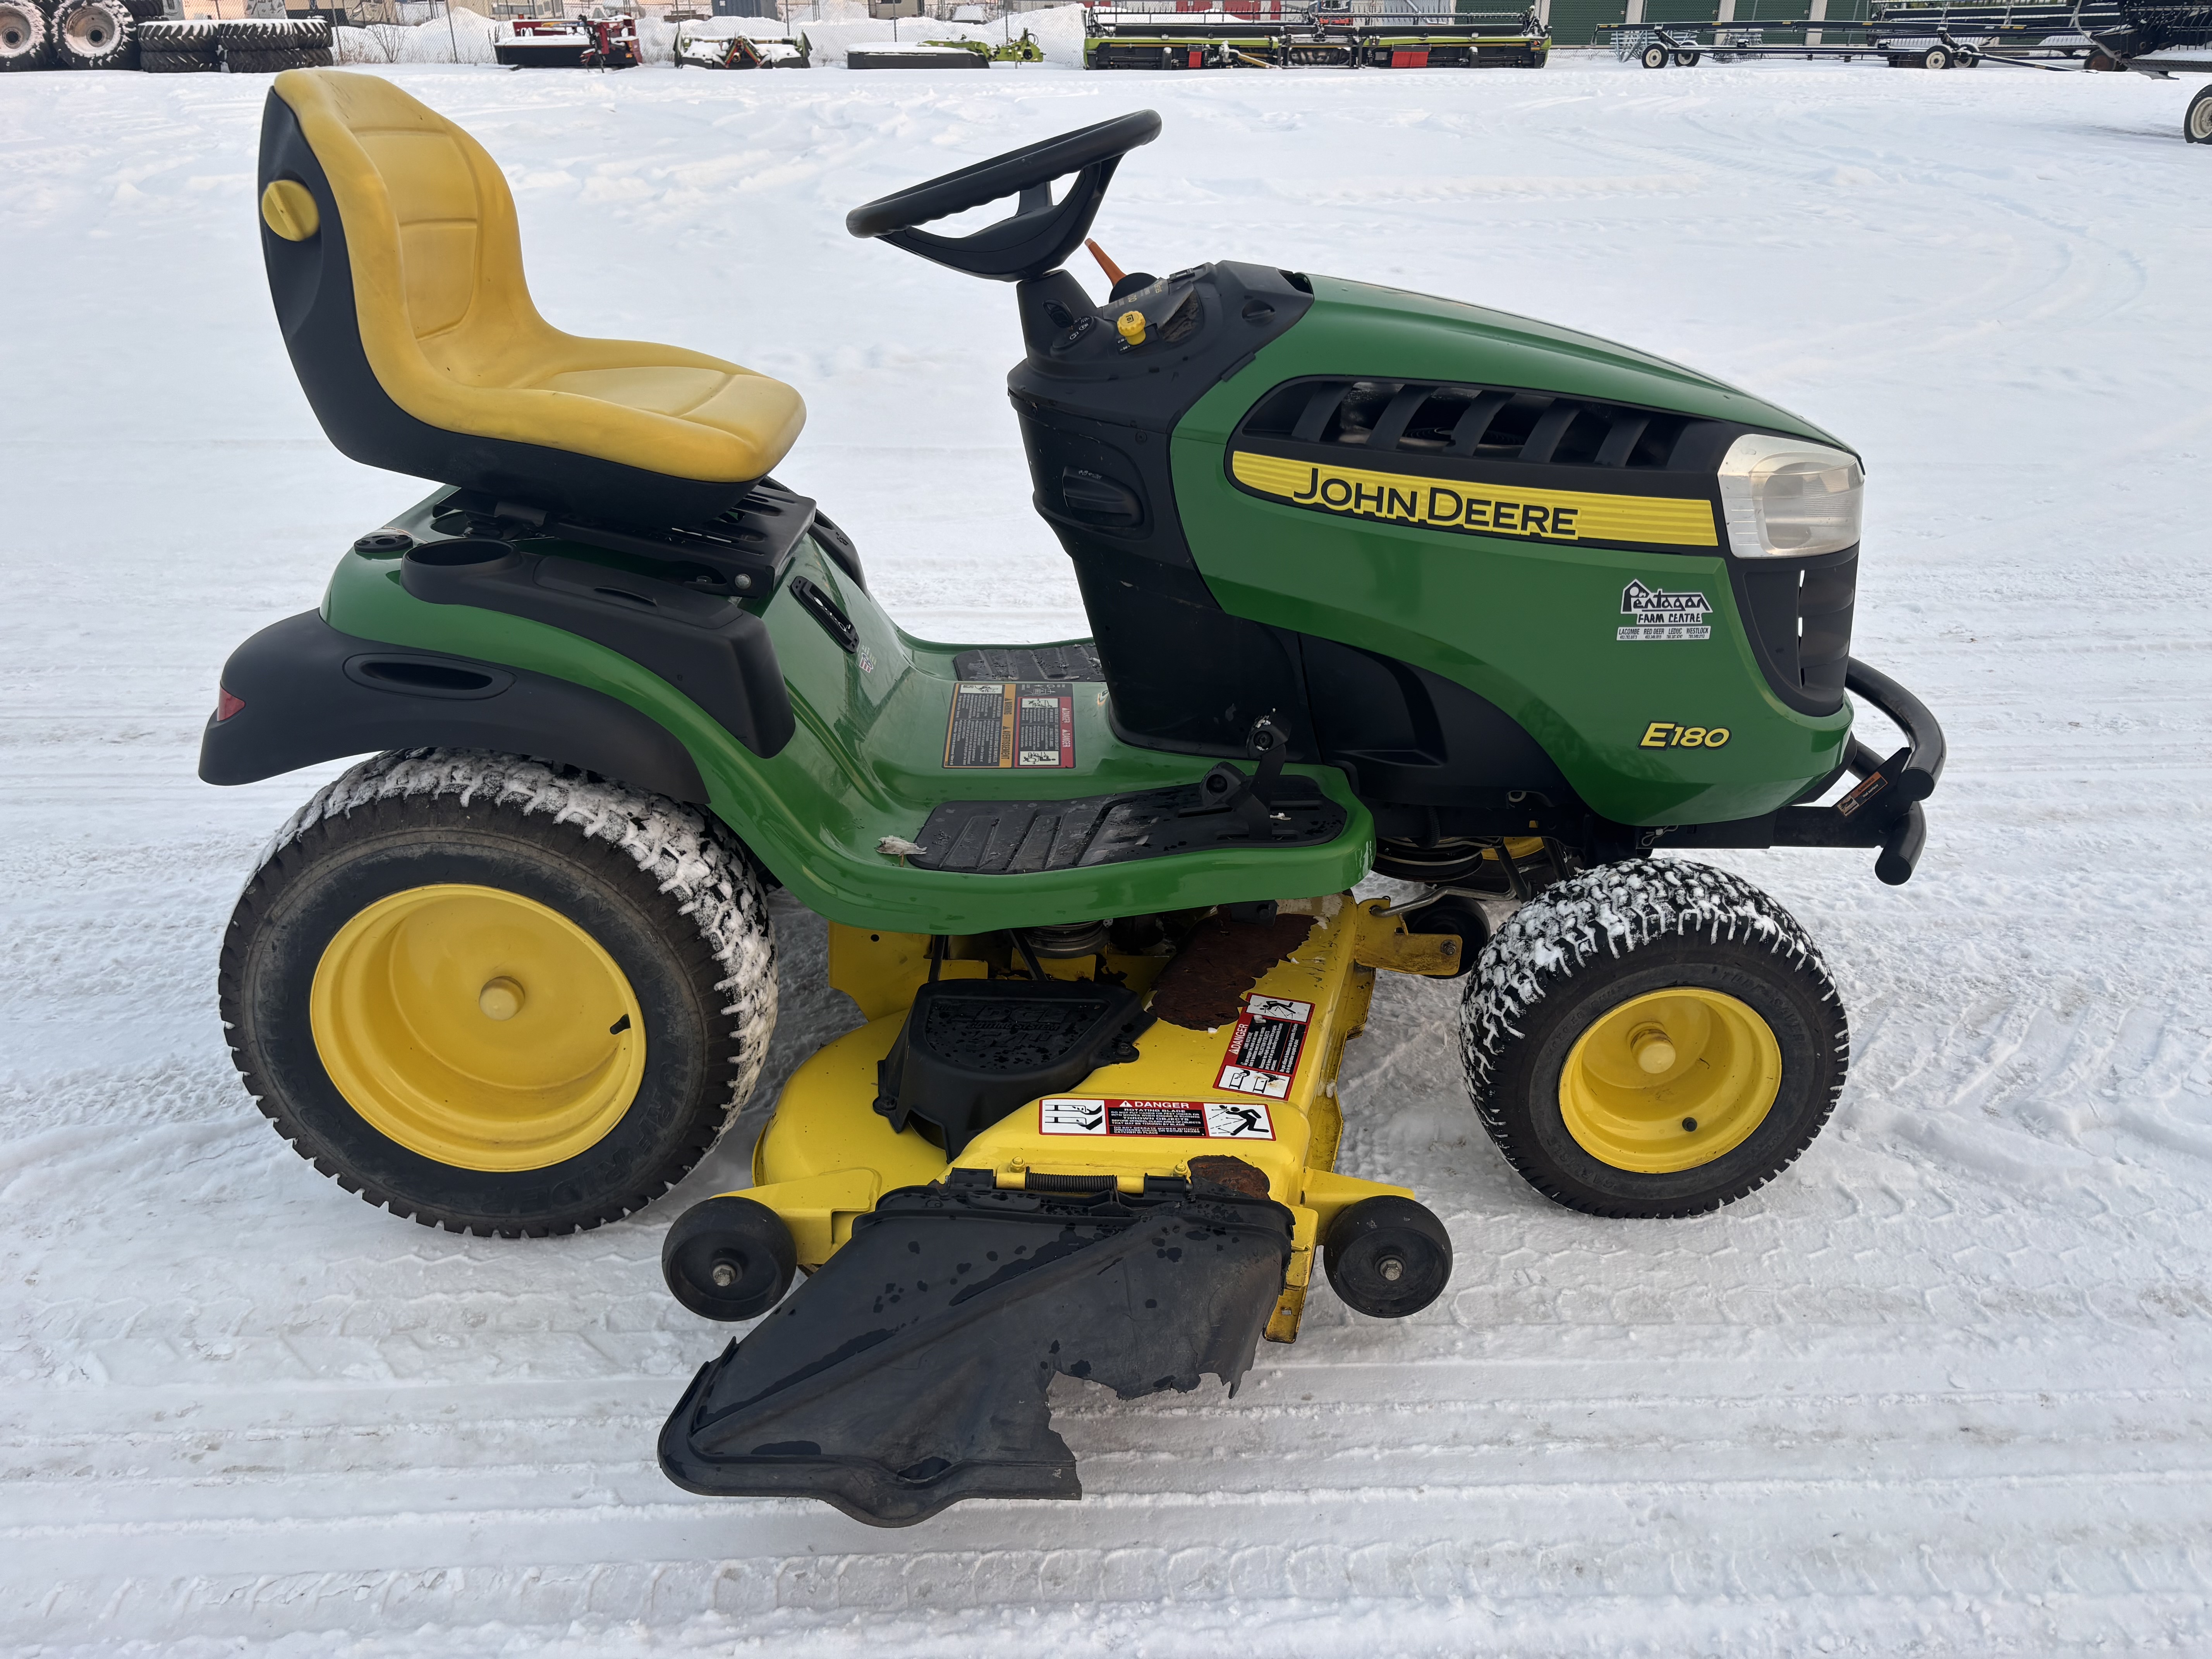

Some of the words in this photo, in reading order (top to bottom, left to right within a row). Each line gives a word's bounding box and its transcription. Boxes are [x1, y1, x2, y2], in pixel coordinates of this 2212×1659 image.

[1294, 467, 1417, 519] JOHN
[1428, 487, 1578, 535] DEERE
[1623, 581, 1710, 612] Pentagon
[1638, 614, 1664, 623] FARM
[1669, 613, 1701, 623] CENTRE
[1062, 710, 1070, 723] DANGER
[1001, 731, 1010, 759] AVERTISSEMENT
[1062, 732, 1070, 747] DANGER
[1640, 722, 1730, 748] E180
[1015, 1022, 1061, 1031] SYSTEM
[1231, 1024, 1249, 1051] DANGER
[638, 1036, 688, 1155] TURF
[481, 1148, 633, 1214] RIDER
